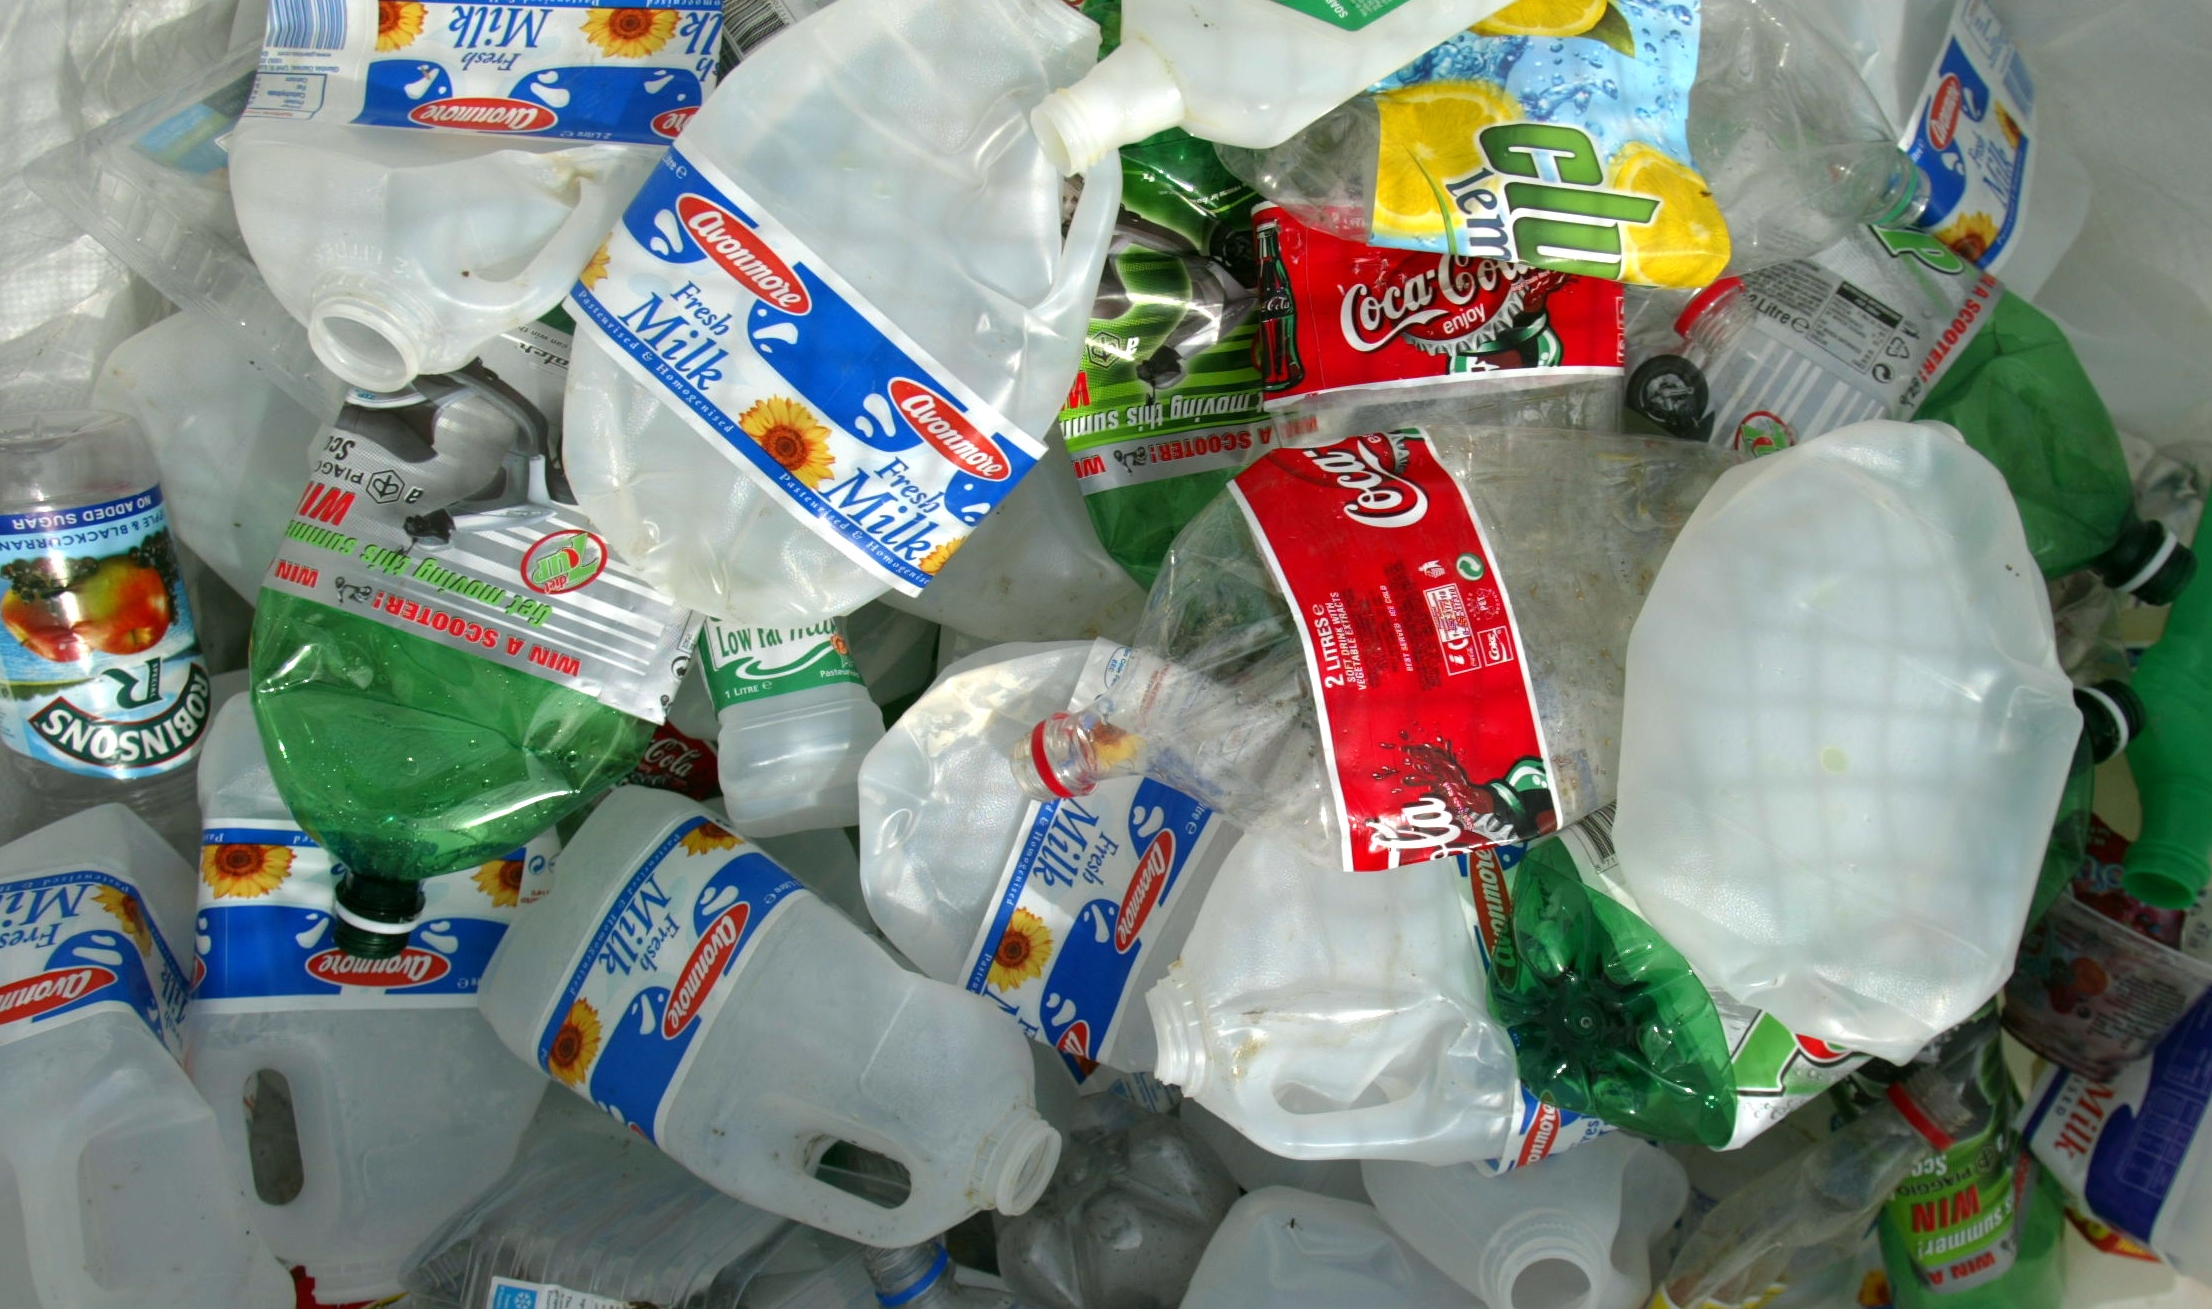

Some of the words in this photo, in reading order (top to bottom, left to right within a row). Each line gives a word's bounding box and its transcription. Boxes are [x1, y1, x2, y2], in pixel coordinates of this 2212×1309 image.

[447, 5, 547, 47] Milk
[460, 50, 521, 71] Fresh
[670, 280, 731, 336] Fresh
[1442, 302, 1486, 334] enjoy
[1755, 297, 1793, 325] Litre
[618, 292, 723, 391] Milk
[577, 290, 640, 351] Pasteurised
[655, 361, 733, 433] Homogenised
[1125, 404, 1163, 431] this
[1168, 389, 1250, 422] moving
[1142, 430, 1253, 463] SCOOTER!
[136, 495, 153, 509] NO
[777, 473, 850, 529] Pasteurised
[875, 456, 946, 513] Fresh
[12, 510, 77, 531] SUGAR
[83, 502, 133, 522] ADDED
[820, 468, 932, 562] Milk
[273, 559, 320, 588] WIN
[359, 545, 411, 577] this
[411, 559, 505, 608] moving
[370, 592, 497, 648] SCOOTER!
[508, 593, 552, 627] Get
[1323, 602, 1341, 625] WITH
[503, 635, 524, 655] A
[1313, 616, 1341, 671] LITRES
[1334, 626, 1349, 656] DRINK
[526, 645, 580, 677] WIN
[1323, 673, 1345, 689] 2
[40, 668, 210, 761] ROBINSONS
[1034, 797, 1101, 887] Milk
[1083, 830, 1128, 890] Fresh
[596, 872, 672, 973] Milk
[635, 911, 683, 977] Fresh
[1526, 1101, 1557, 1165] onmore
[1909, 1183, 1980, 1234] WIN
